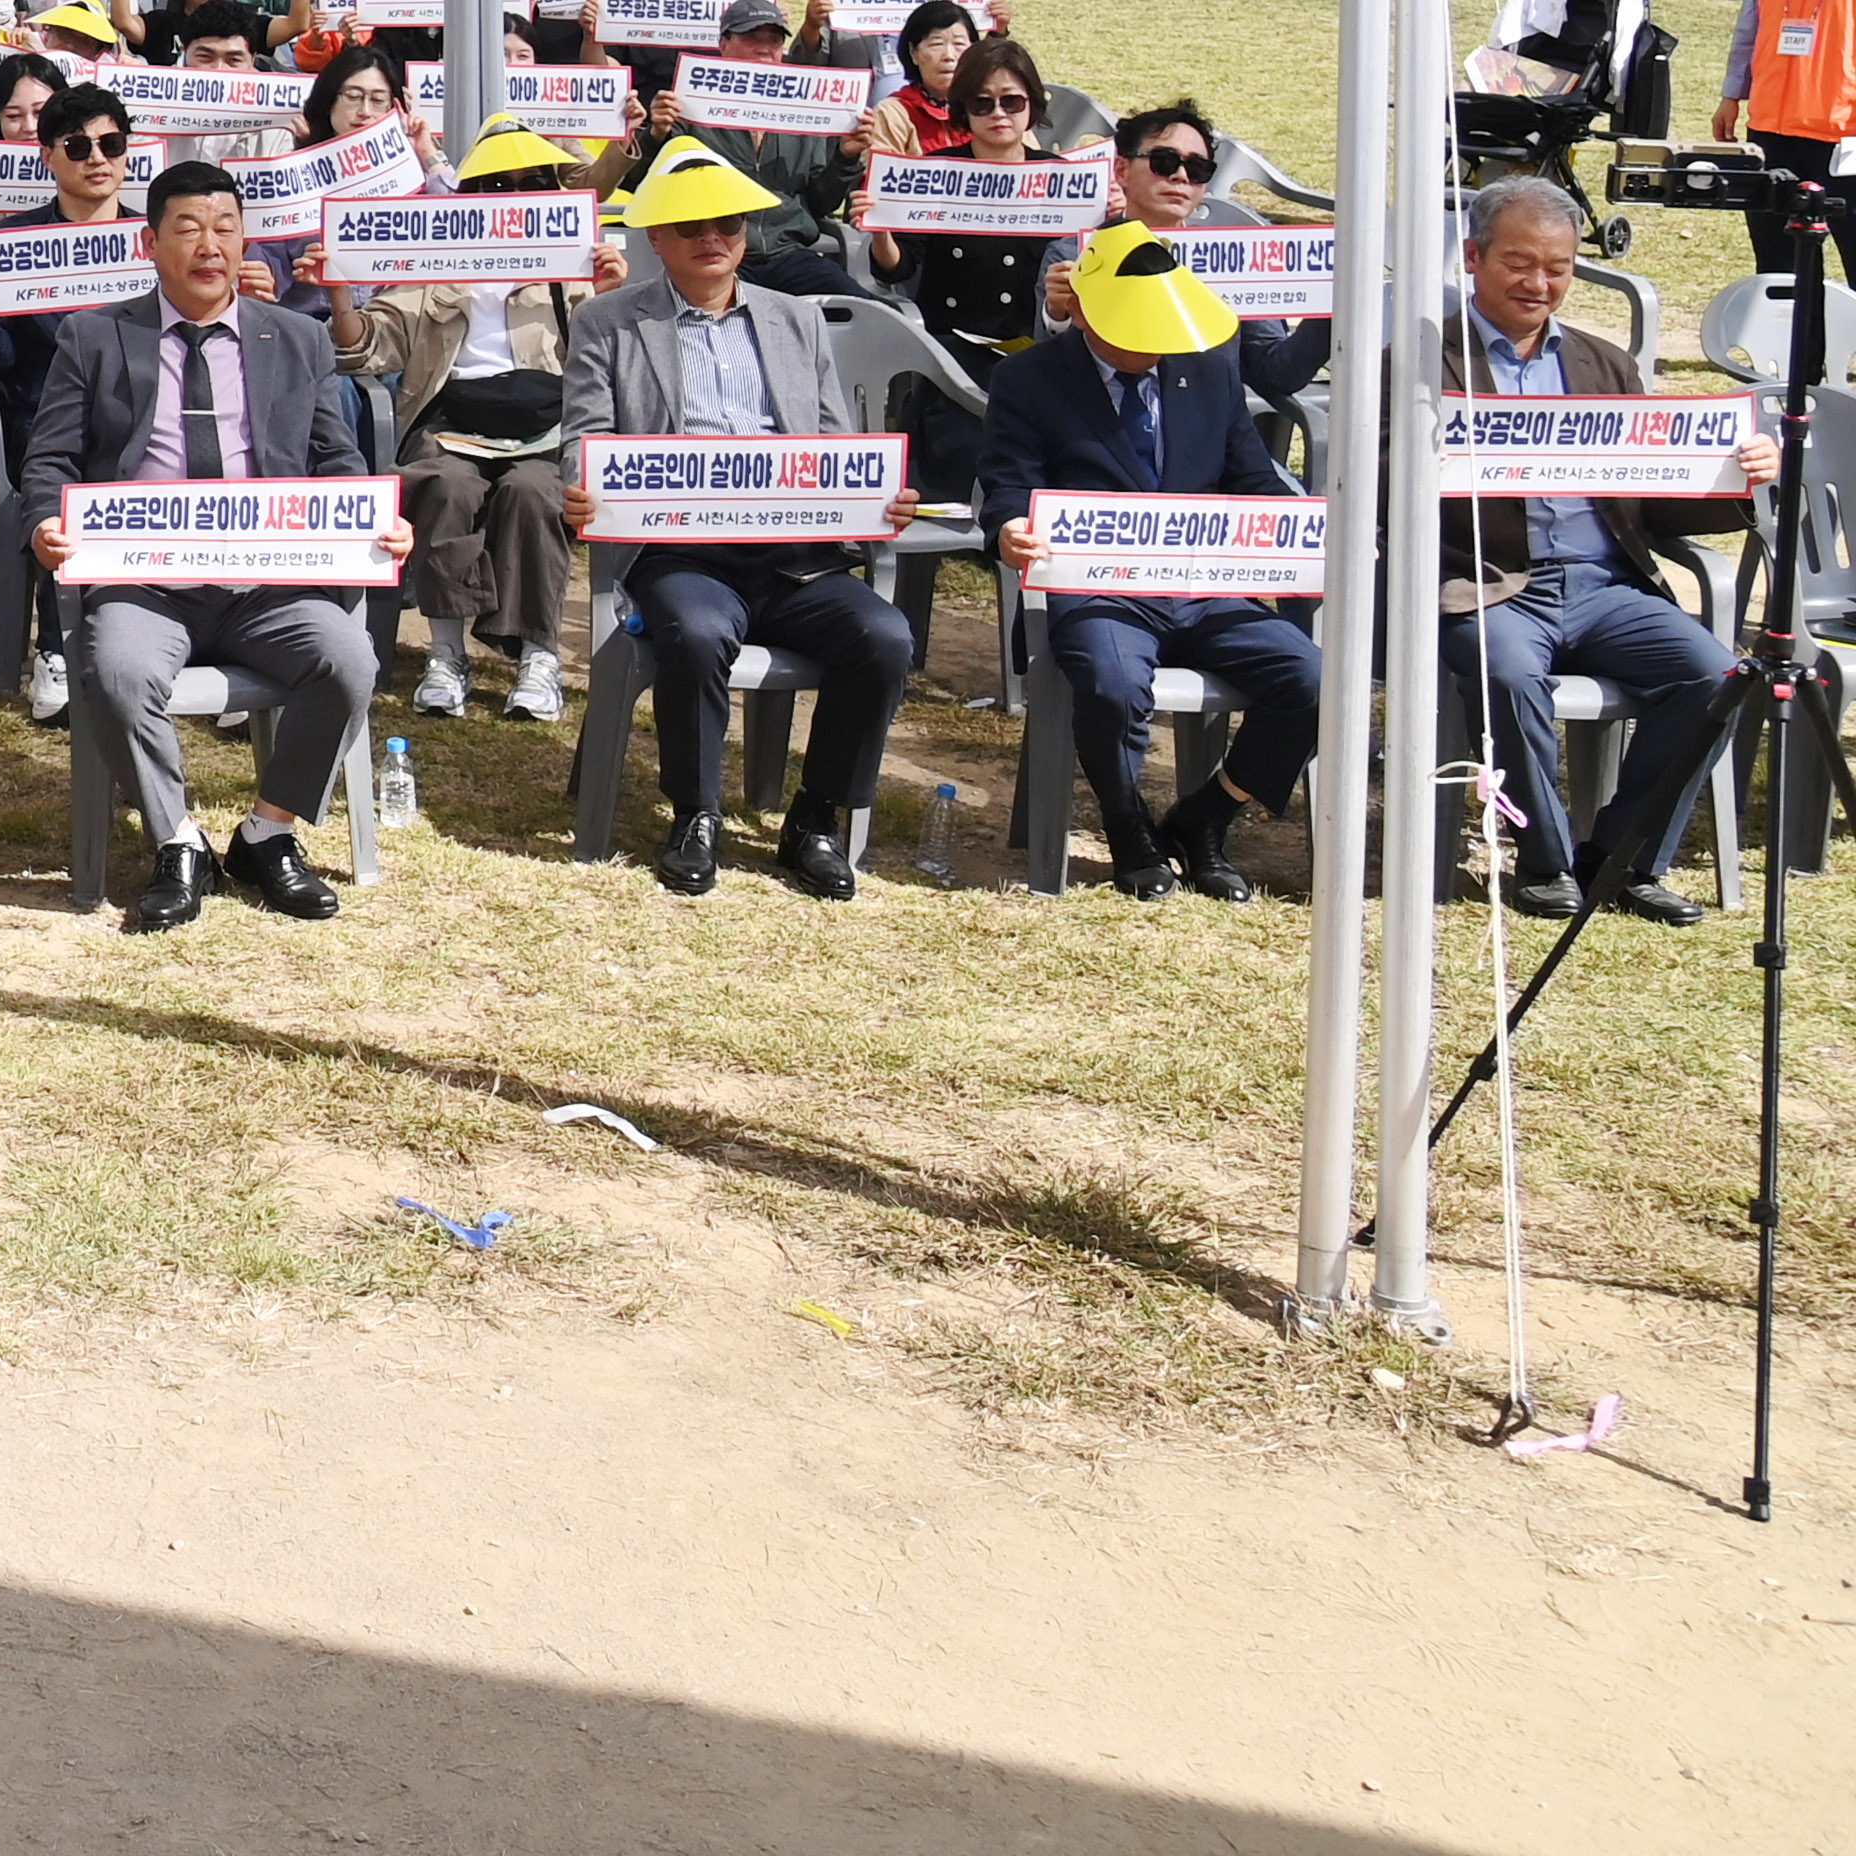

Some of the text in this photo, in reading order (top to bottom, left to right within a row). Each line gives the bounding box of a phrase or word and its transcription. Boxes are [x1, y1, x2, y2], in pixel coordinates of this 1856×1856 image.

[1784, 37, 1806, 45] STAFF
[687, 67, 860, 104] 우주항공 복합도시 사천시
[338, 206, 579, 241] 소상공인이 살아야 사천이 산다
[1444, 409, 1738, 448] 소상공인이 살아야 사천이 산다
[603, 452, 884, 489] 소상공인이 살아야 사천이 산다
[1481, 465, 1691, 482] KFME 사천시소상공인연합회
[83, 495, 375, 530] 소상공인이 살아야 사천이 산다
[642, 511, 842, 526] KFME 사천시소상공인연합회
[1050, 509, 1298, 548] 소상공인이 살아야 사천이
[124, 552, 333, 566] KFME 사천시소상공인연합회
[1087, 567, 1297, 582] KFME 사천시소상공인연합회
